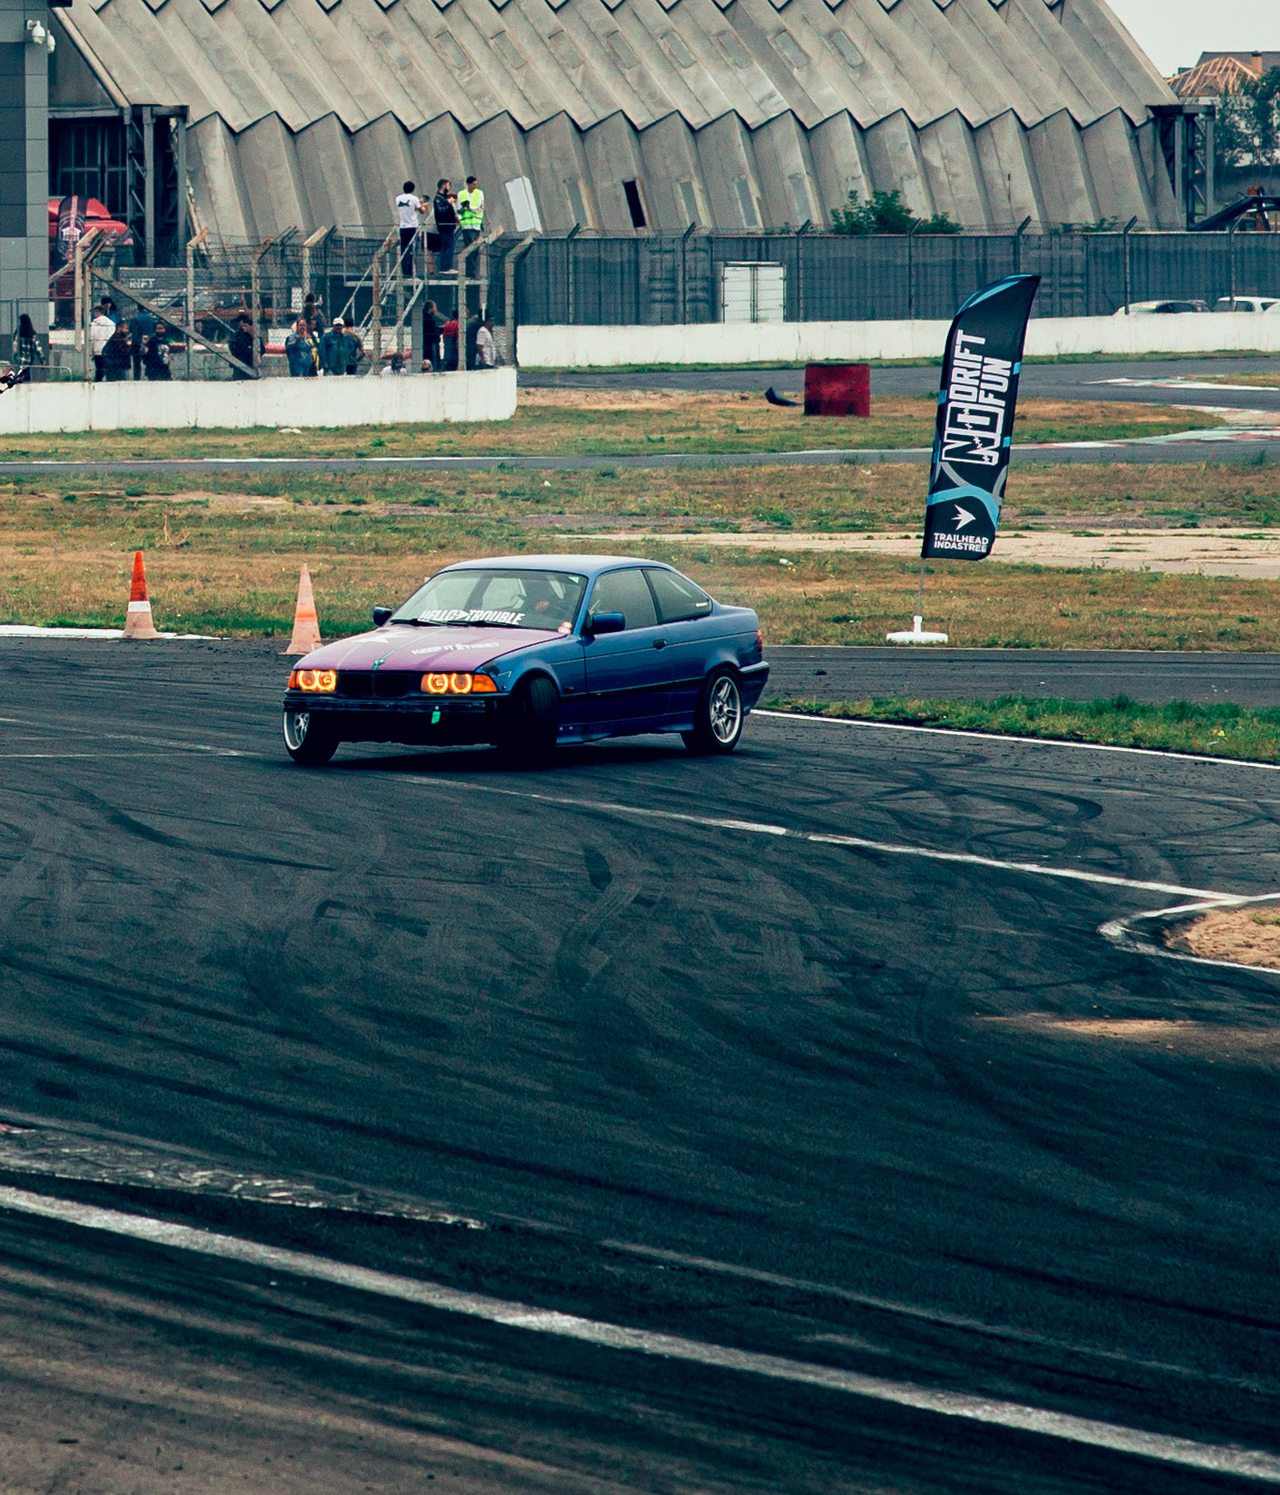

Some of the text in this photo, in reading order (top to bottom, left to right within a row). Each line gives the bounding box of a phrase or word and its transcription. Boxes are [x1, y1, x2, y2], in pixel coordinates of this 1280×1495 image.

[948, 329, 986, 403] DRIFT
[978, 356, 1012, 407] FUN
[933, 532, 989, 545] TRAILHEAD
[933, 541, 988, 553] INDASTREE
[465, 609, 525, 625] TROUBLE
